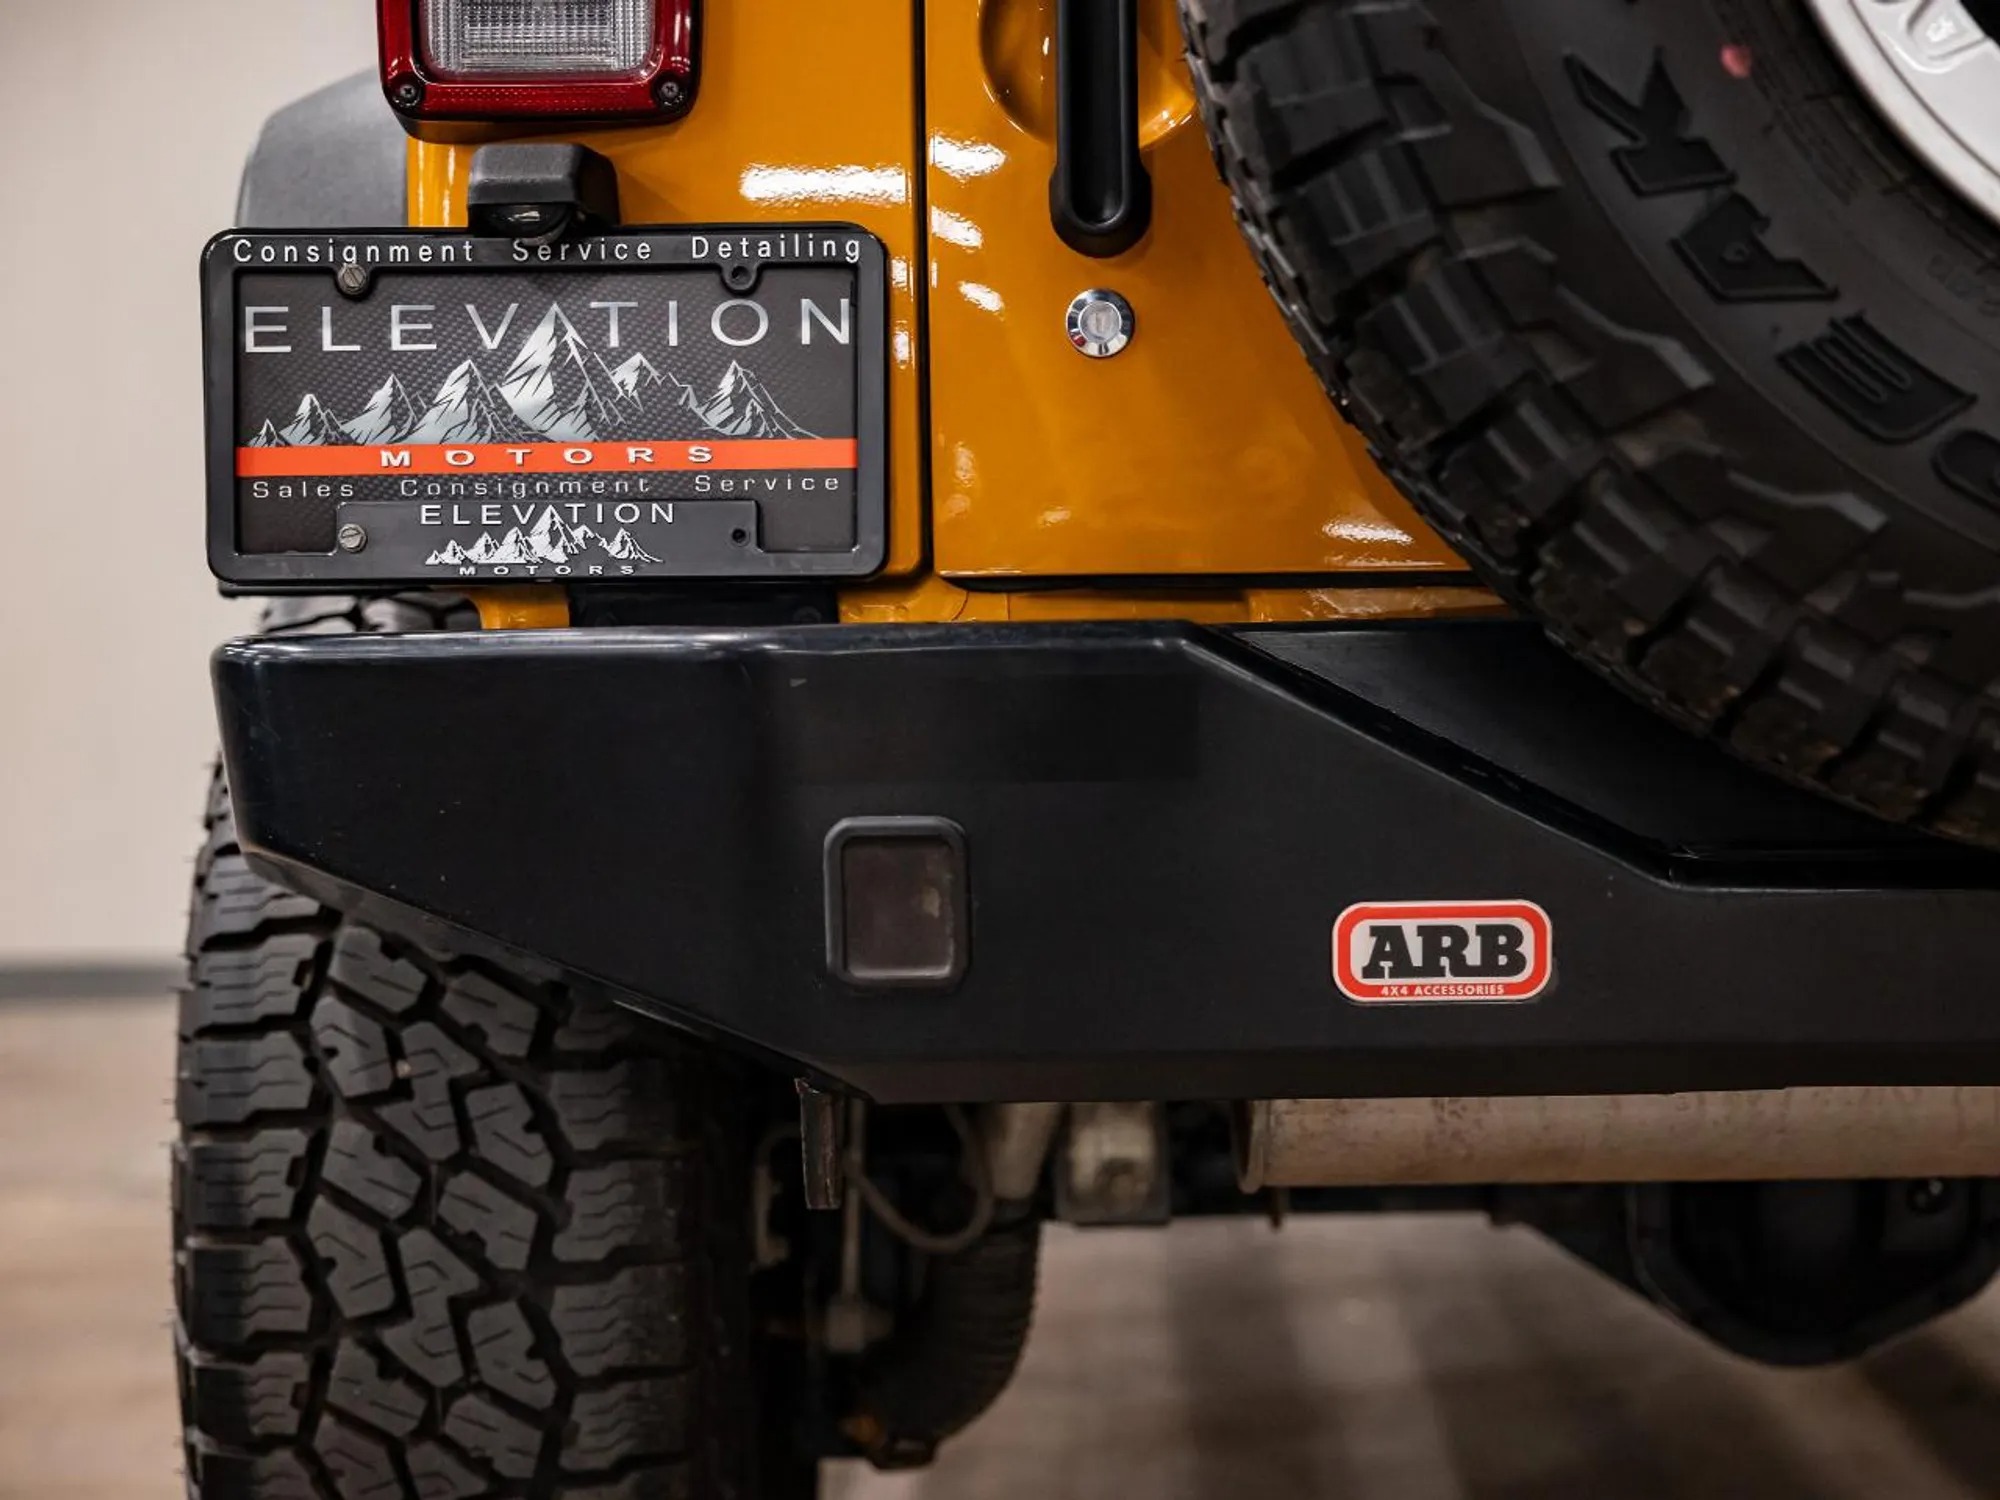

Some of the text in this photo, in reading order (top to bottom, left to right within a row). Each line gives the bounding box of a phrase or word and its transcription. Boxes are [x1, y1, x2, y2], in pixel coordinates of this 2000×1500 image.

[233, 233, 860, 264] Consignment Service Detailing
[245, 298, 850, 353] ELEVATION
[380, 446, 713, 468] MOTORS
[252, 474, 840, 499] Sales Consignment Service
[420, 503, 675, 526] ELEVATION
[459, 565, 635, 576] MOTORS
[1361, 923, 1528, 979] ARB
[1380, 984, 1505, 997] 4X4 ACCESSORIES
